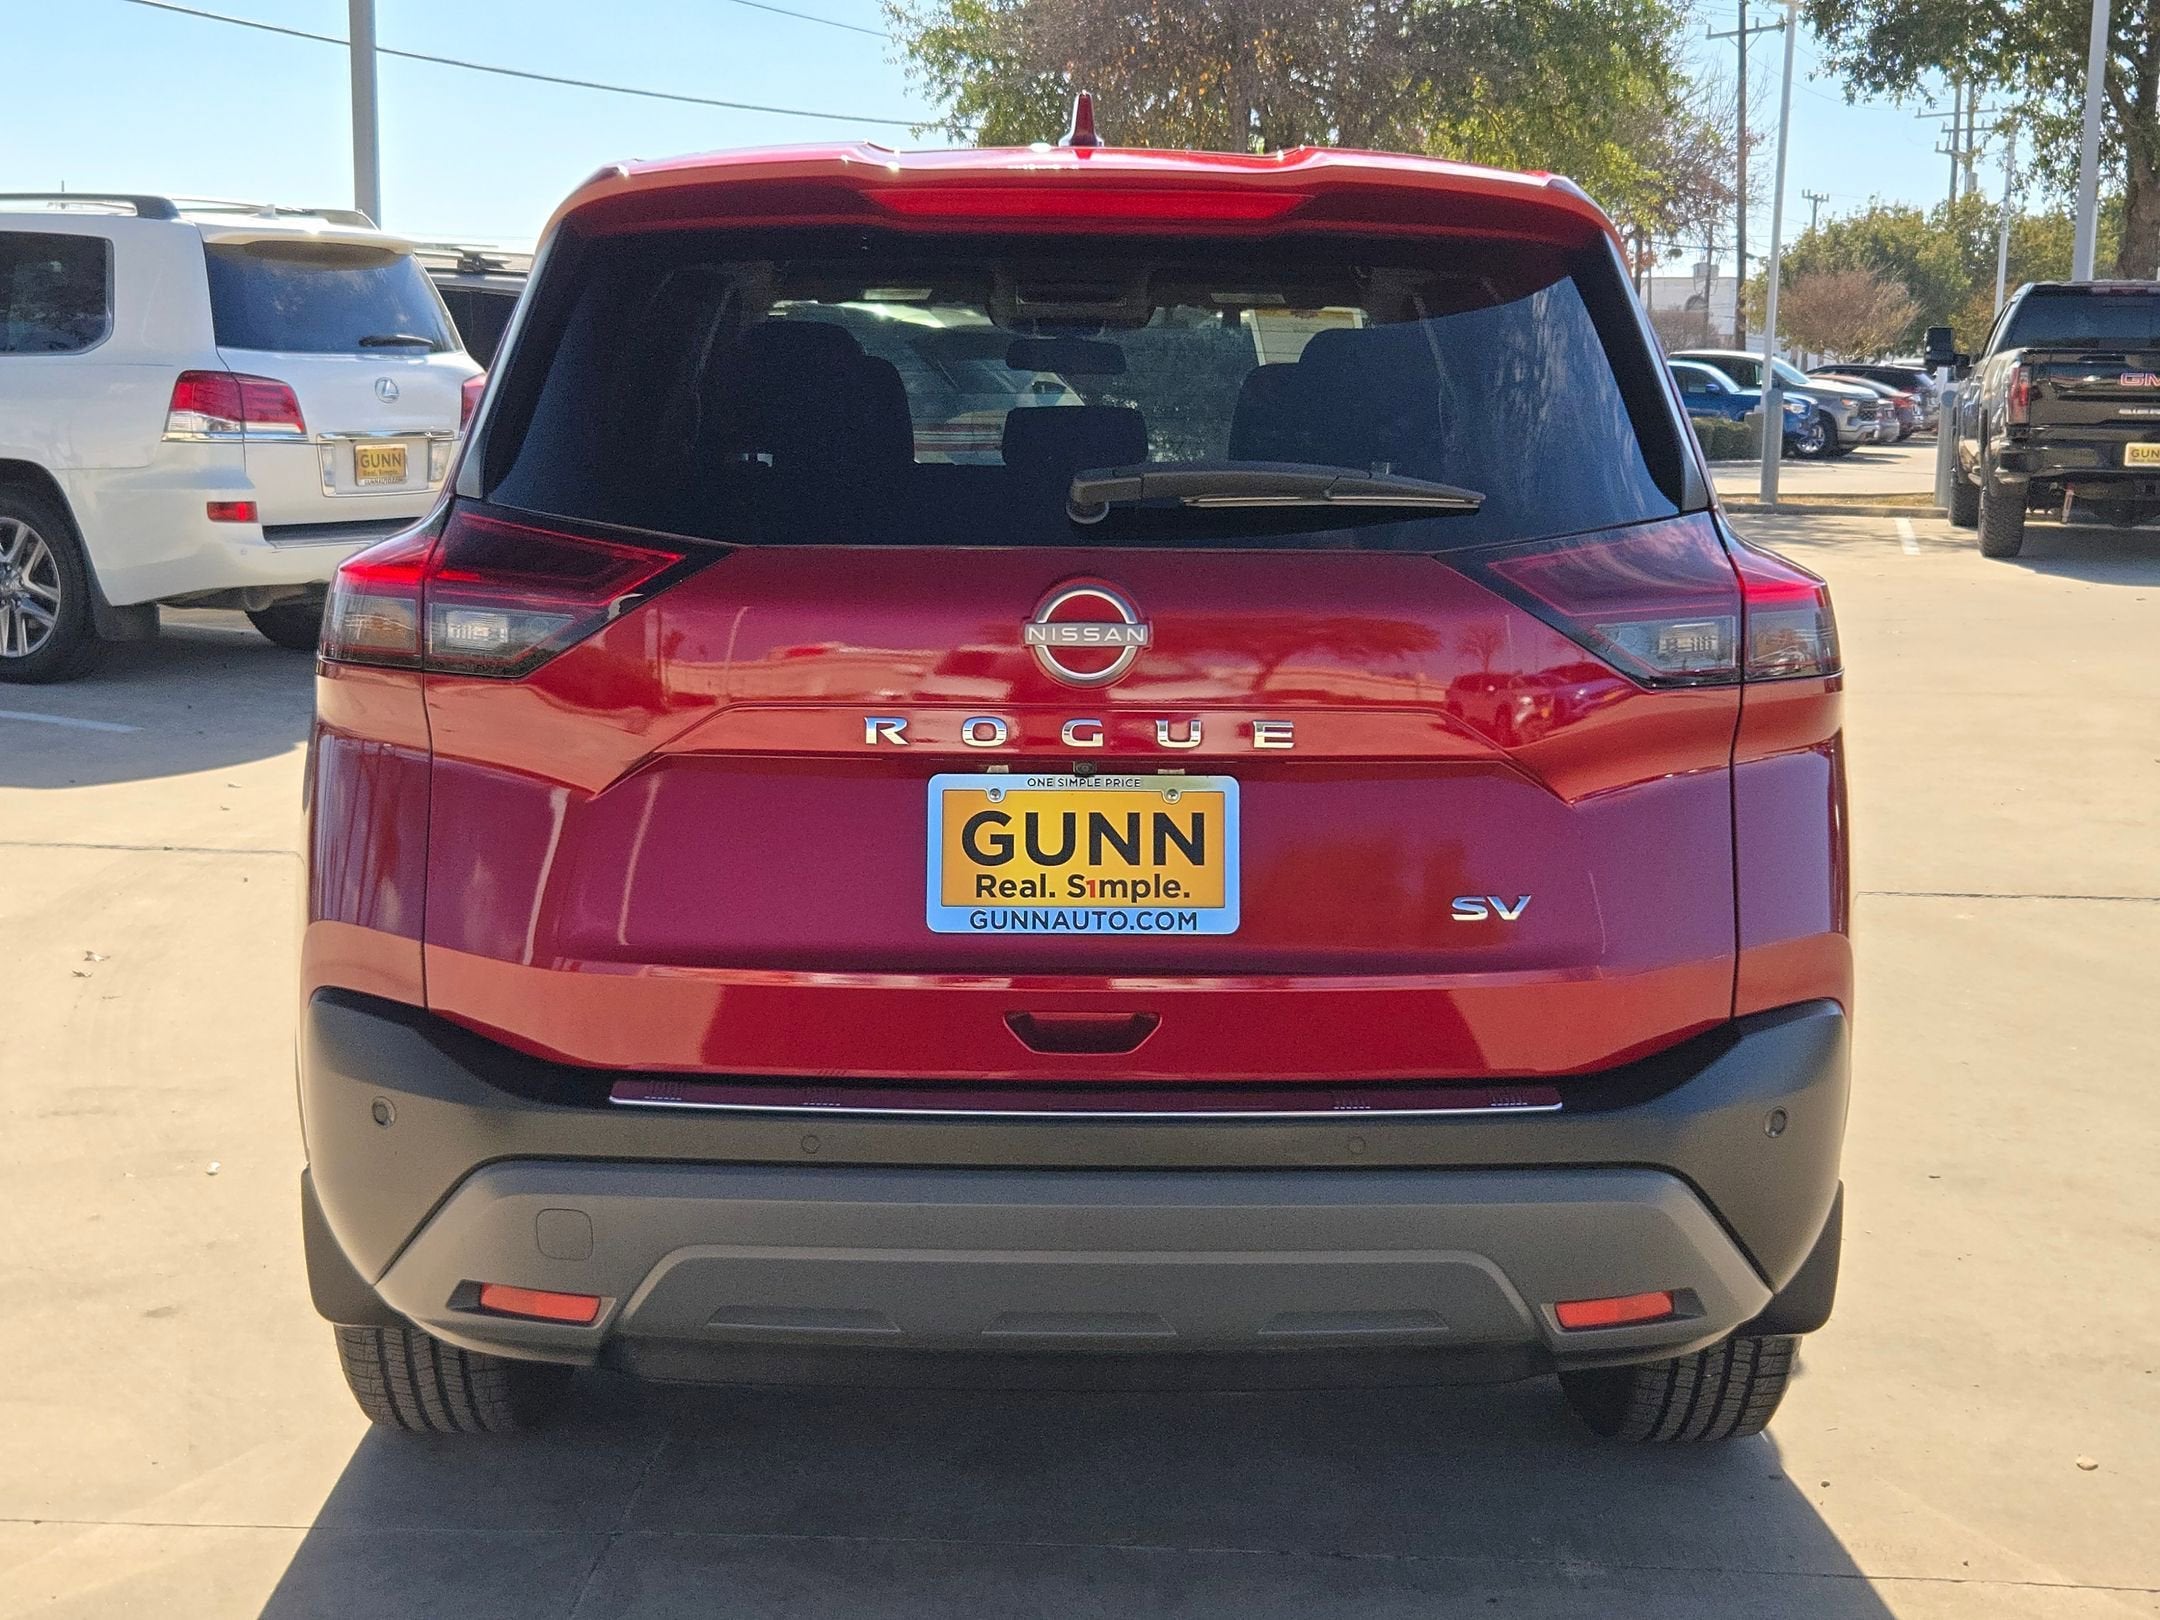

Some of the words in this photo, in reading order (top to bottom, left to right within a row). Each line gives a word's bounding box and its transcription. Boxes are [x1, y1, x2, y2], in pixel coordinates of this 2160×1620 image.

[361, 454, 401, 468] GUNN
[1028, 627, 1144, 642] NISSAN
[864, 716, 1295, 748] ROGUE
[1027, 778, 1053, 787] ONE
[1057, 778, 1101, 787] SIMPLE
[1105, 778, 1141, 788] PRICE
[961, 810, 1205, 866] GUNN
[975, 873, 1056, 898] Real.
[1451, 894, 1532, 921] SV
[970, 910, 1197, 930] GUNNAUTO.COM
